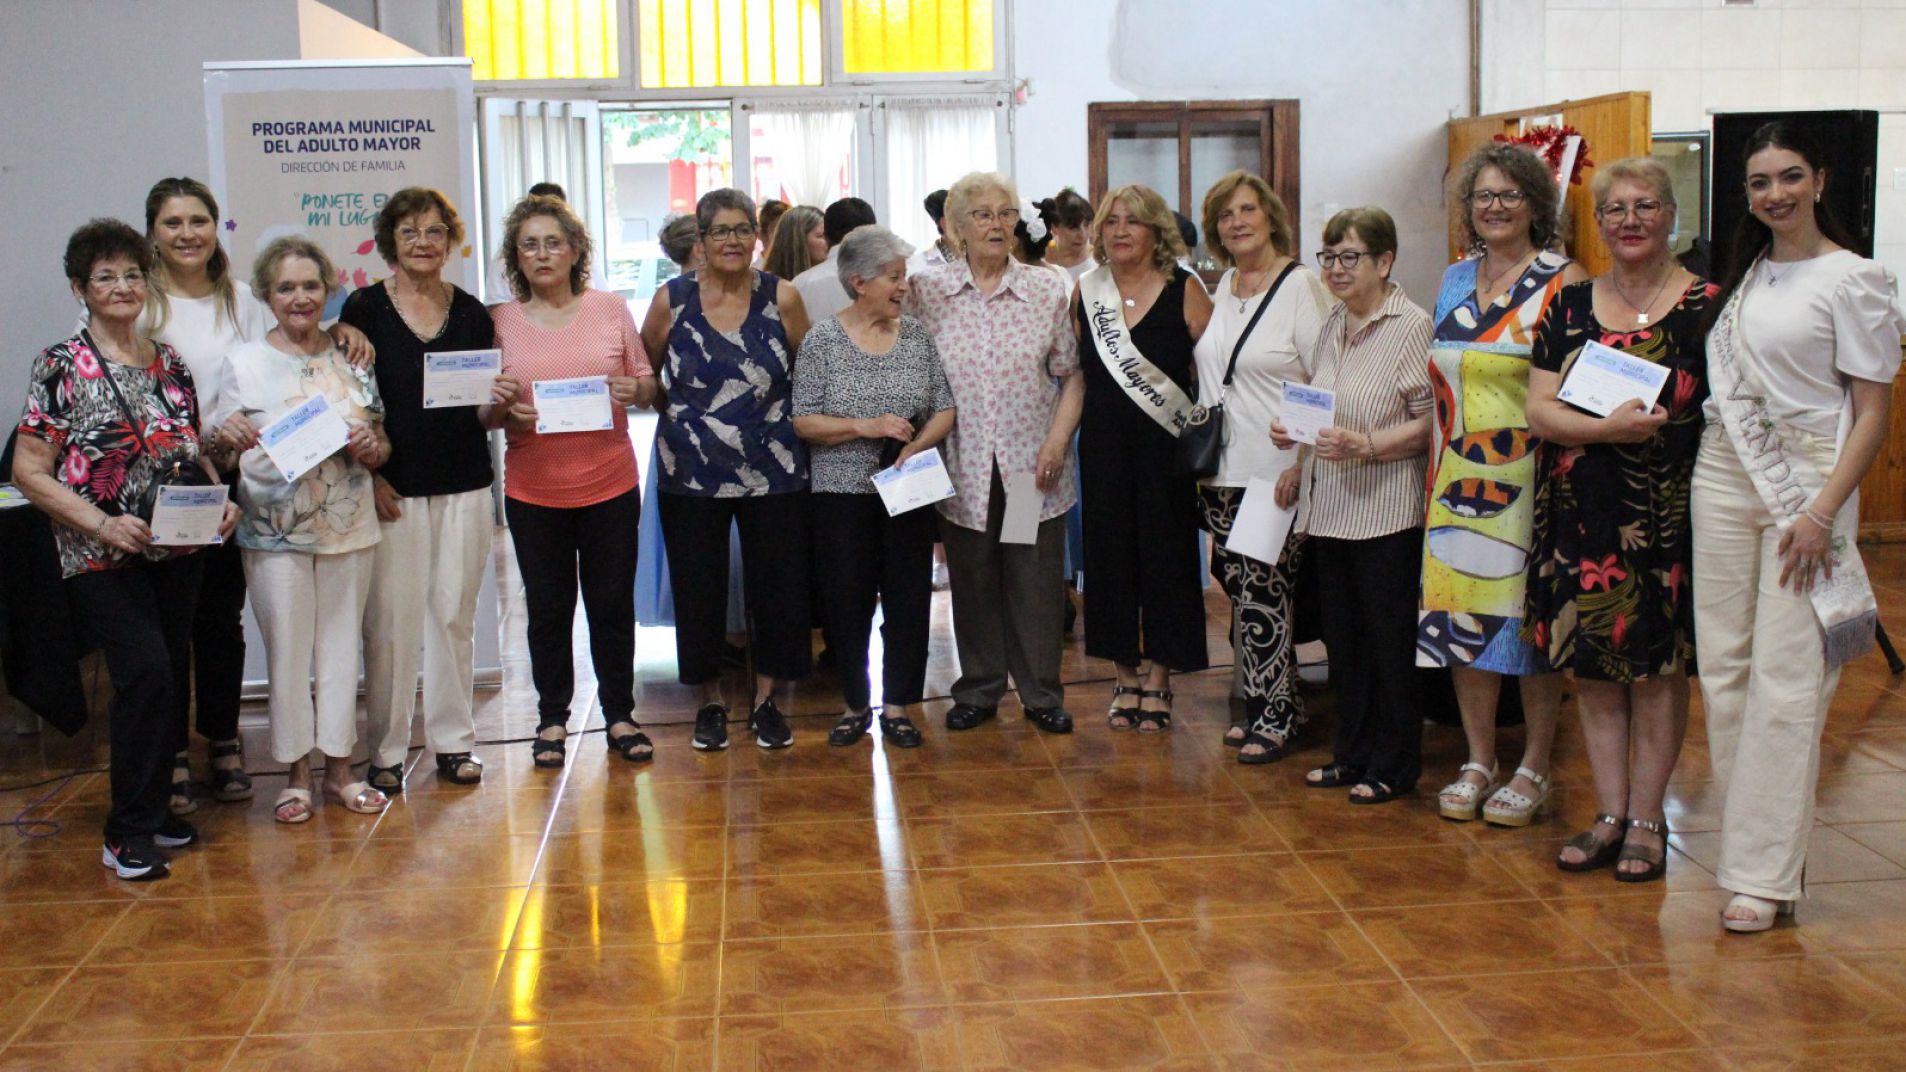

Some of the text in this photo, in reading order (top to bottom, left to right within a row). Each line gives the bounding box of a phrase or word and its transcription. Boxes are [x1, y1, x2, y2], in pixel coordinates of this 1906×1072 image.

[252, 119, 435, 136] PROGRAMA MUNICIPAL
[263, 136, 421, 153] DEL ADULTO MAYOR
[281, 159, 406, 174] DIRECCIÓN DE FAMILIA
[308, 211, 331, 227] MI
[1093, 300, 1167, 408] Adultos Mayores
